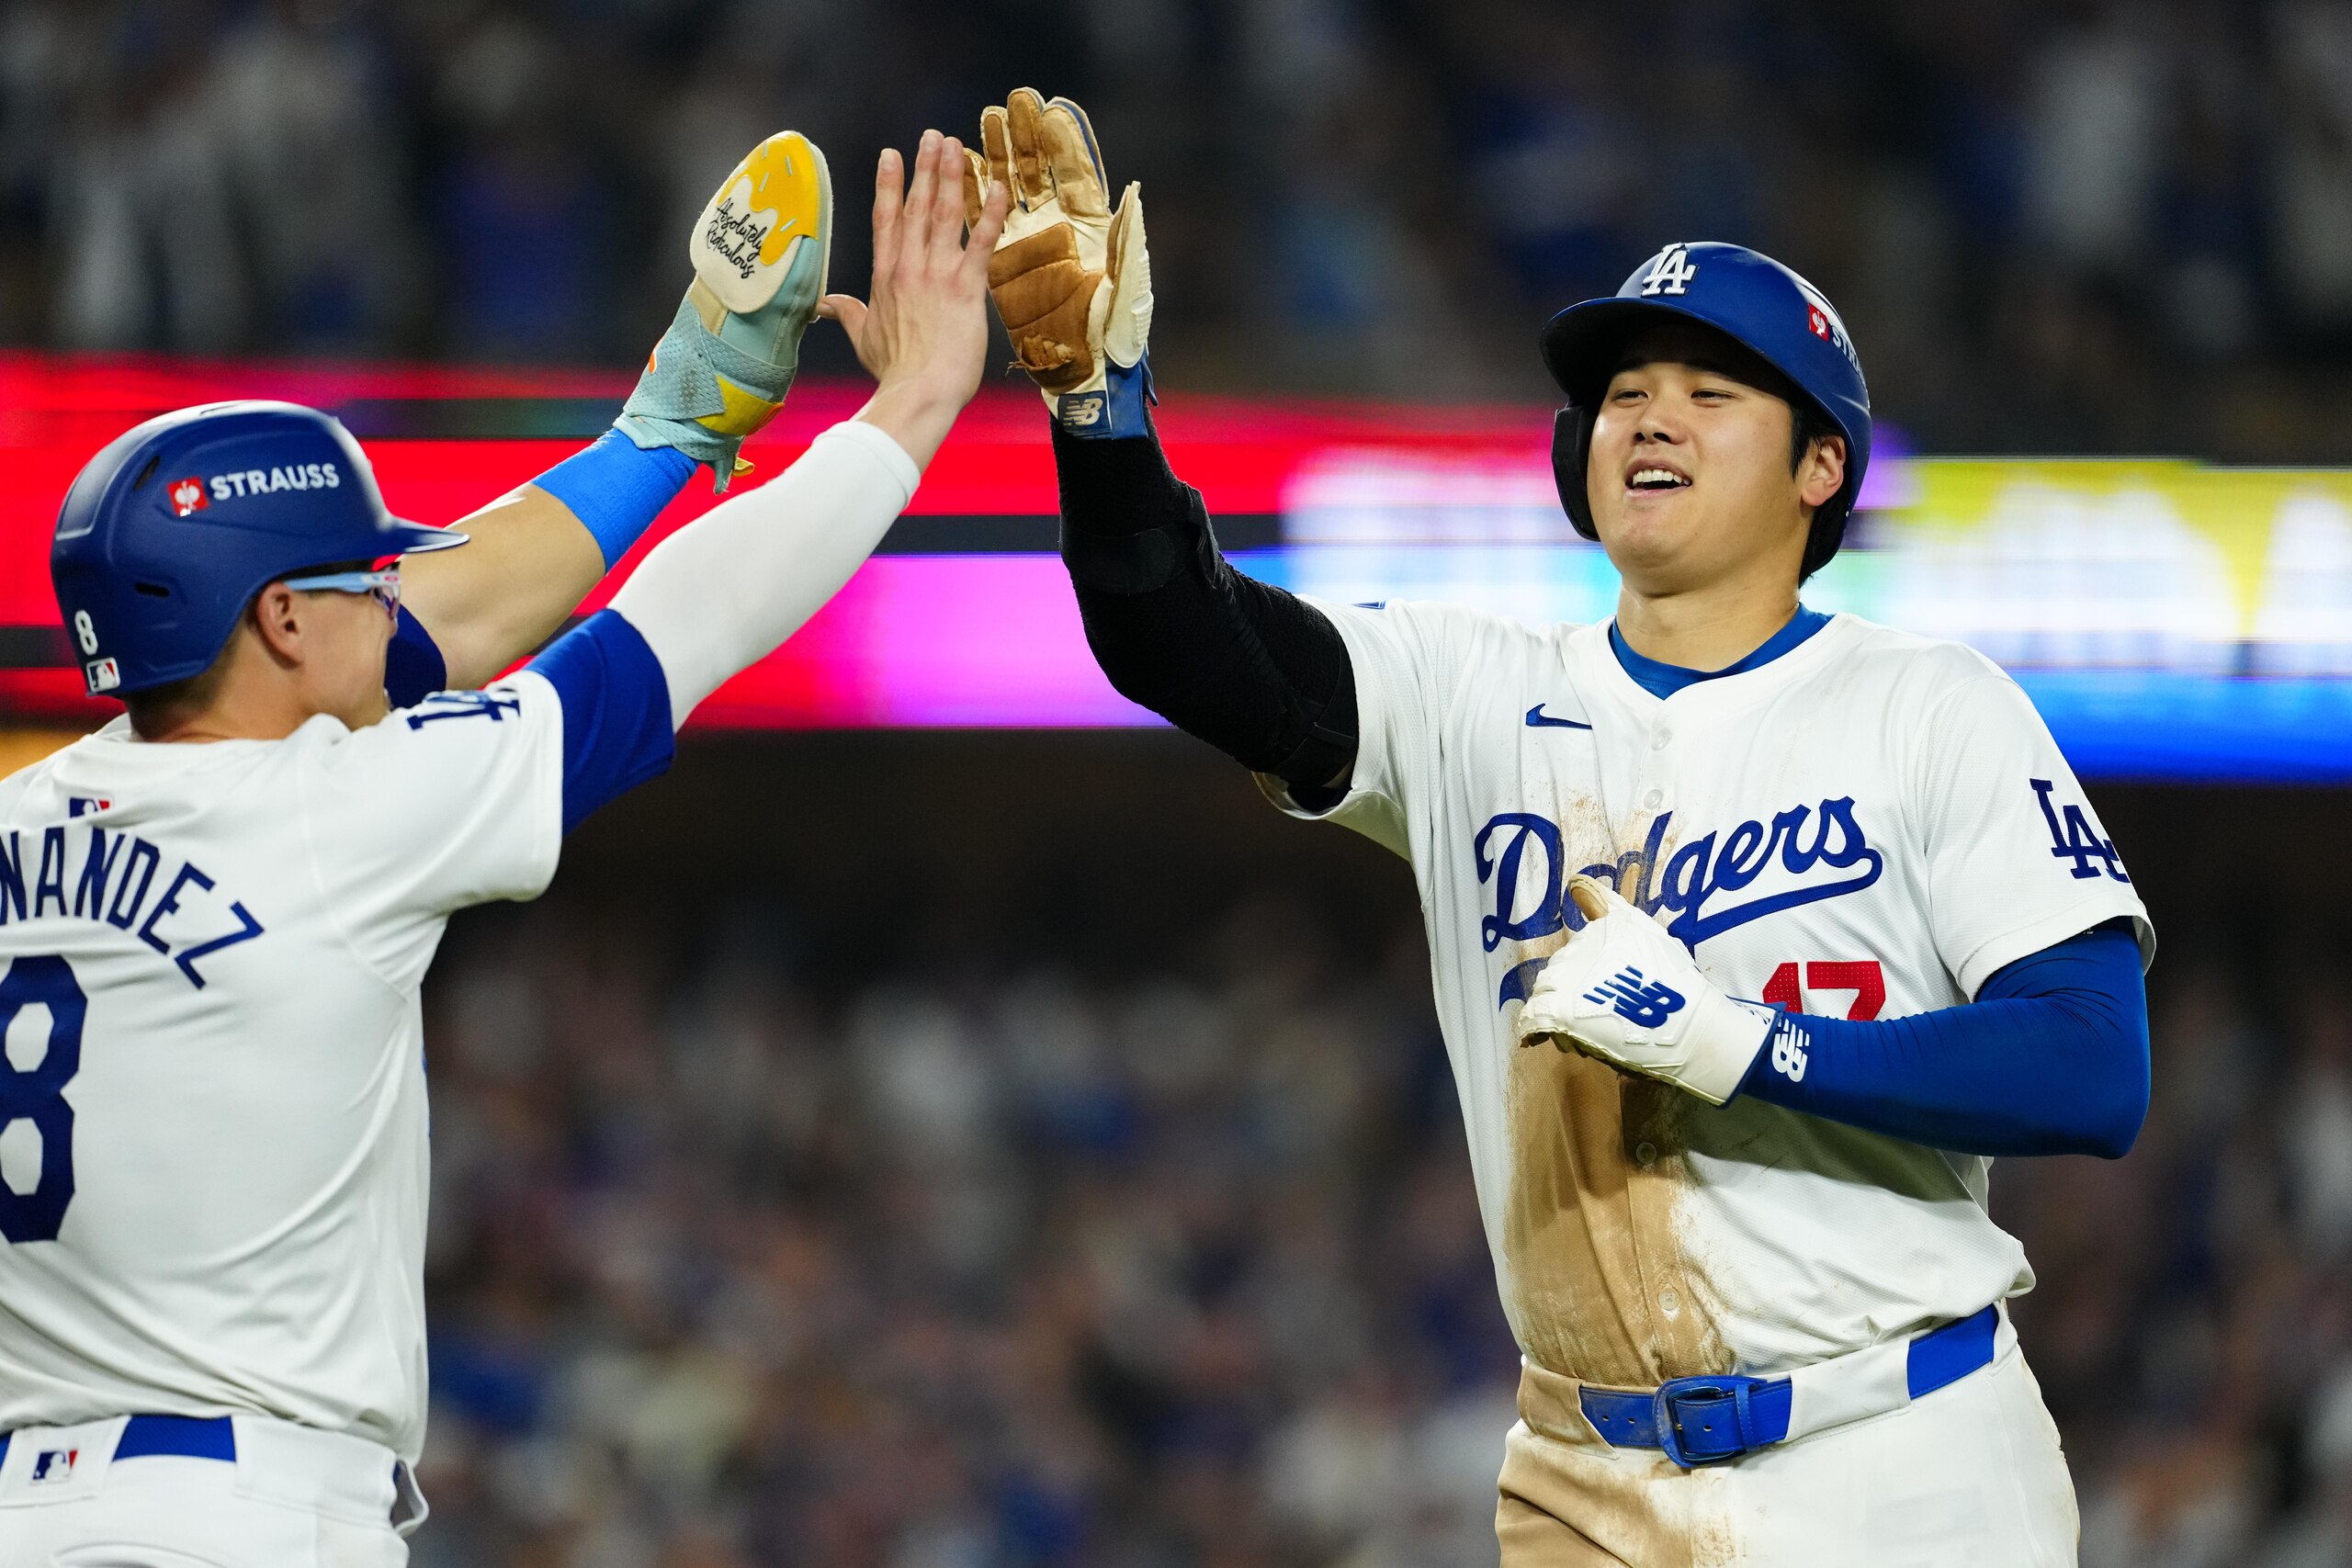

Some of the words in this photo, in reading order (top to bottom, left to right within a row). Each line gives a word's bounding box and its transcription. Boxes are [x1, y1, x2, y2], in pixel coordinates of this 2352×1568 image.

[707, 220, 754, 279] Ridiculous
[716, 197, 767, 262] Absolutely
[1641, 243, 1698, 298] LA
[209, 463, 340, 501] STRAUSS
[74, 609, 98, 656] 8
[2030, 778, 2131, 883] LA
[1475, 795, 1883, 960] Dodgers
[1762, 961, 1886, 1021] 17
[0, 954, 87, 1243] 8
